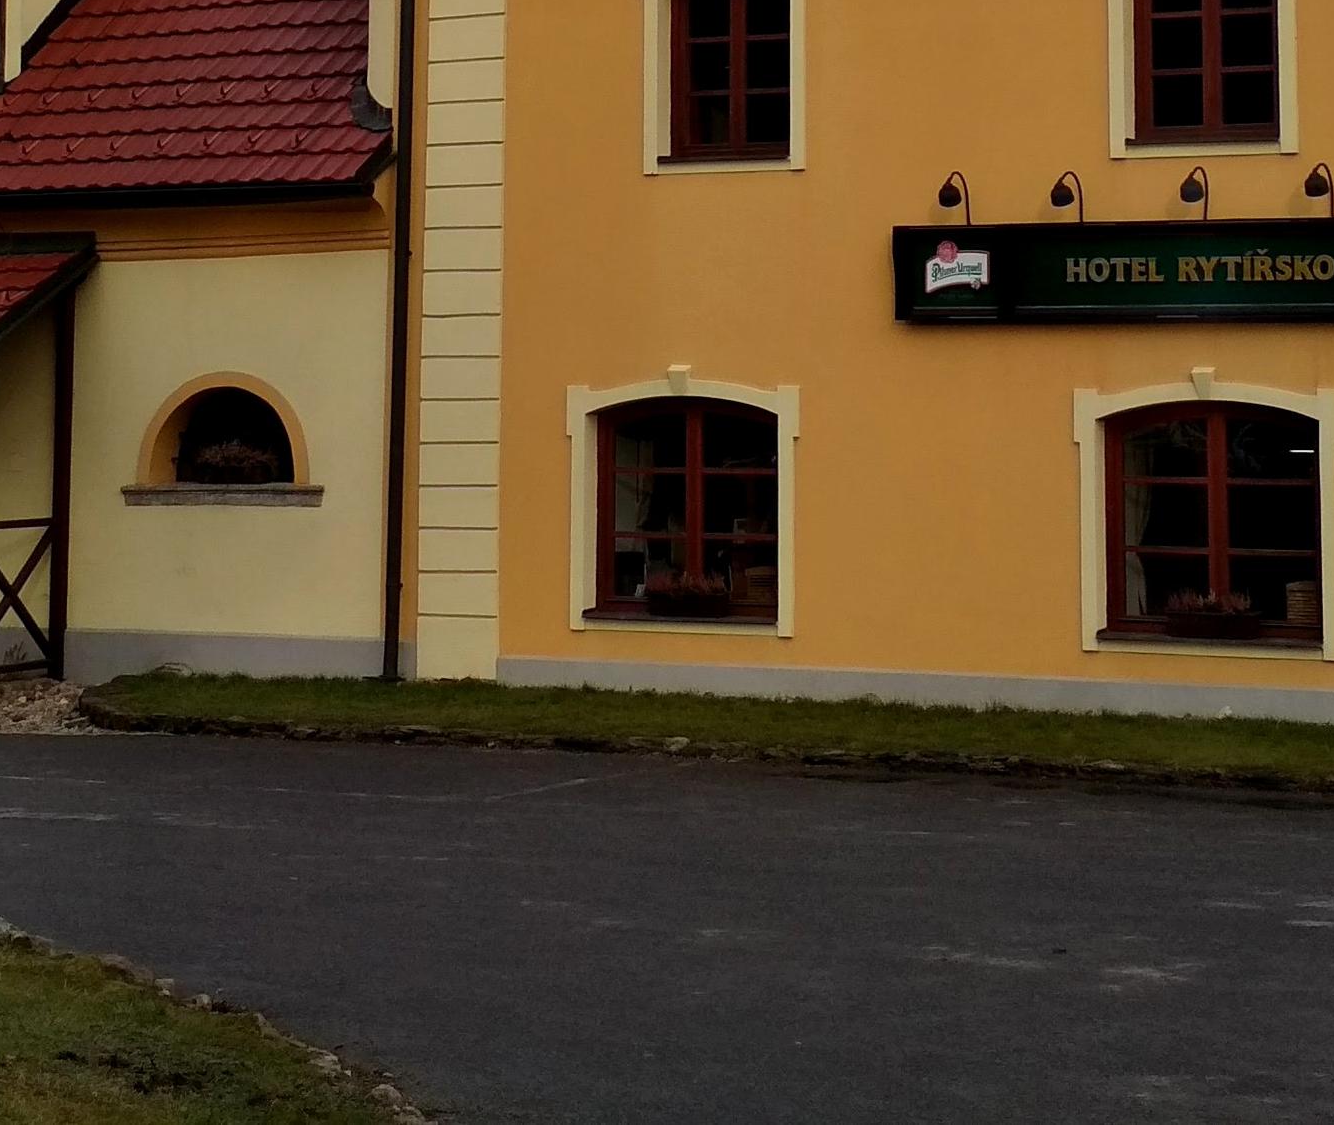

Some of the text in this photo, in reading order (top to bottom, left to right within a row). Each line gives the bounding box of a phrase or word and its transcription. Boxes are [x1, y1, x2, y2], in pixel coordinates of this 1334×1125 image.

[931, 261, 982, 283] Pilsner Urquell
[1065, 256, 1166, 283] HOTEL
